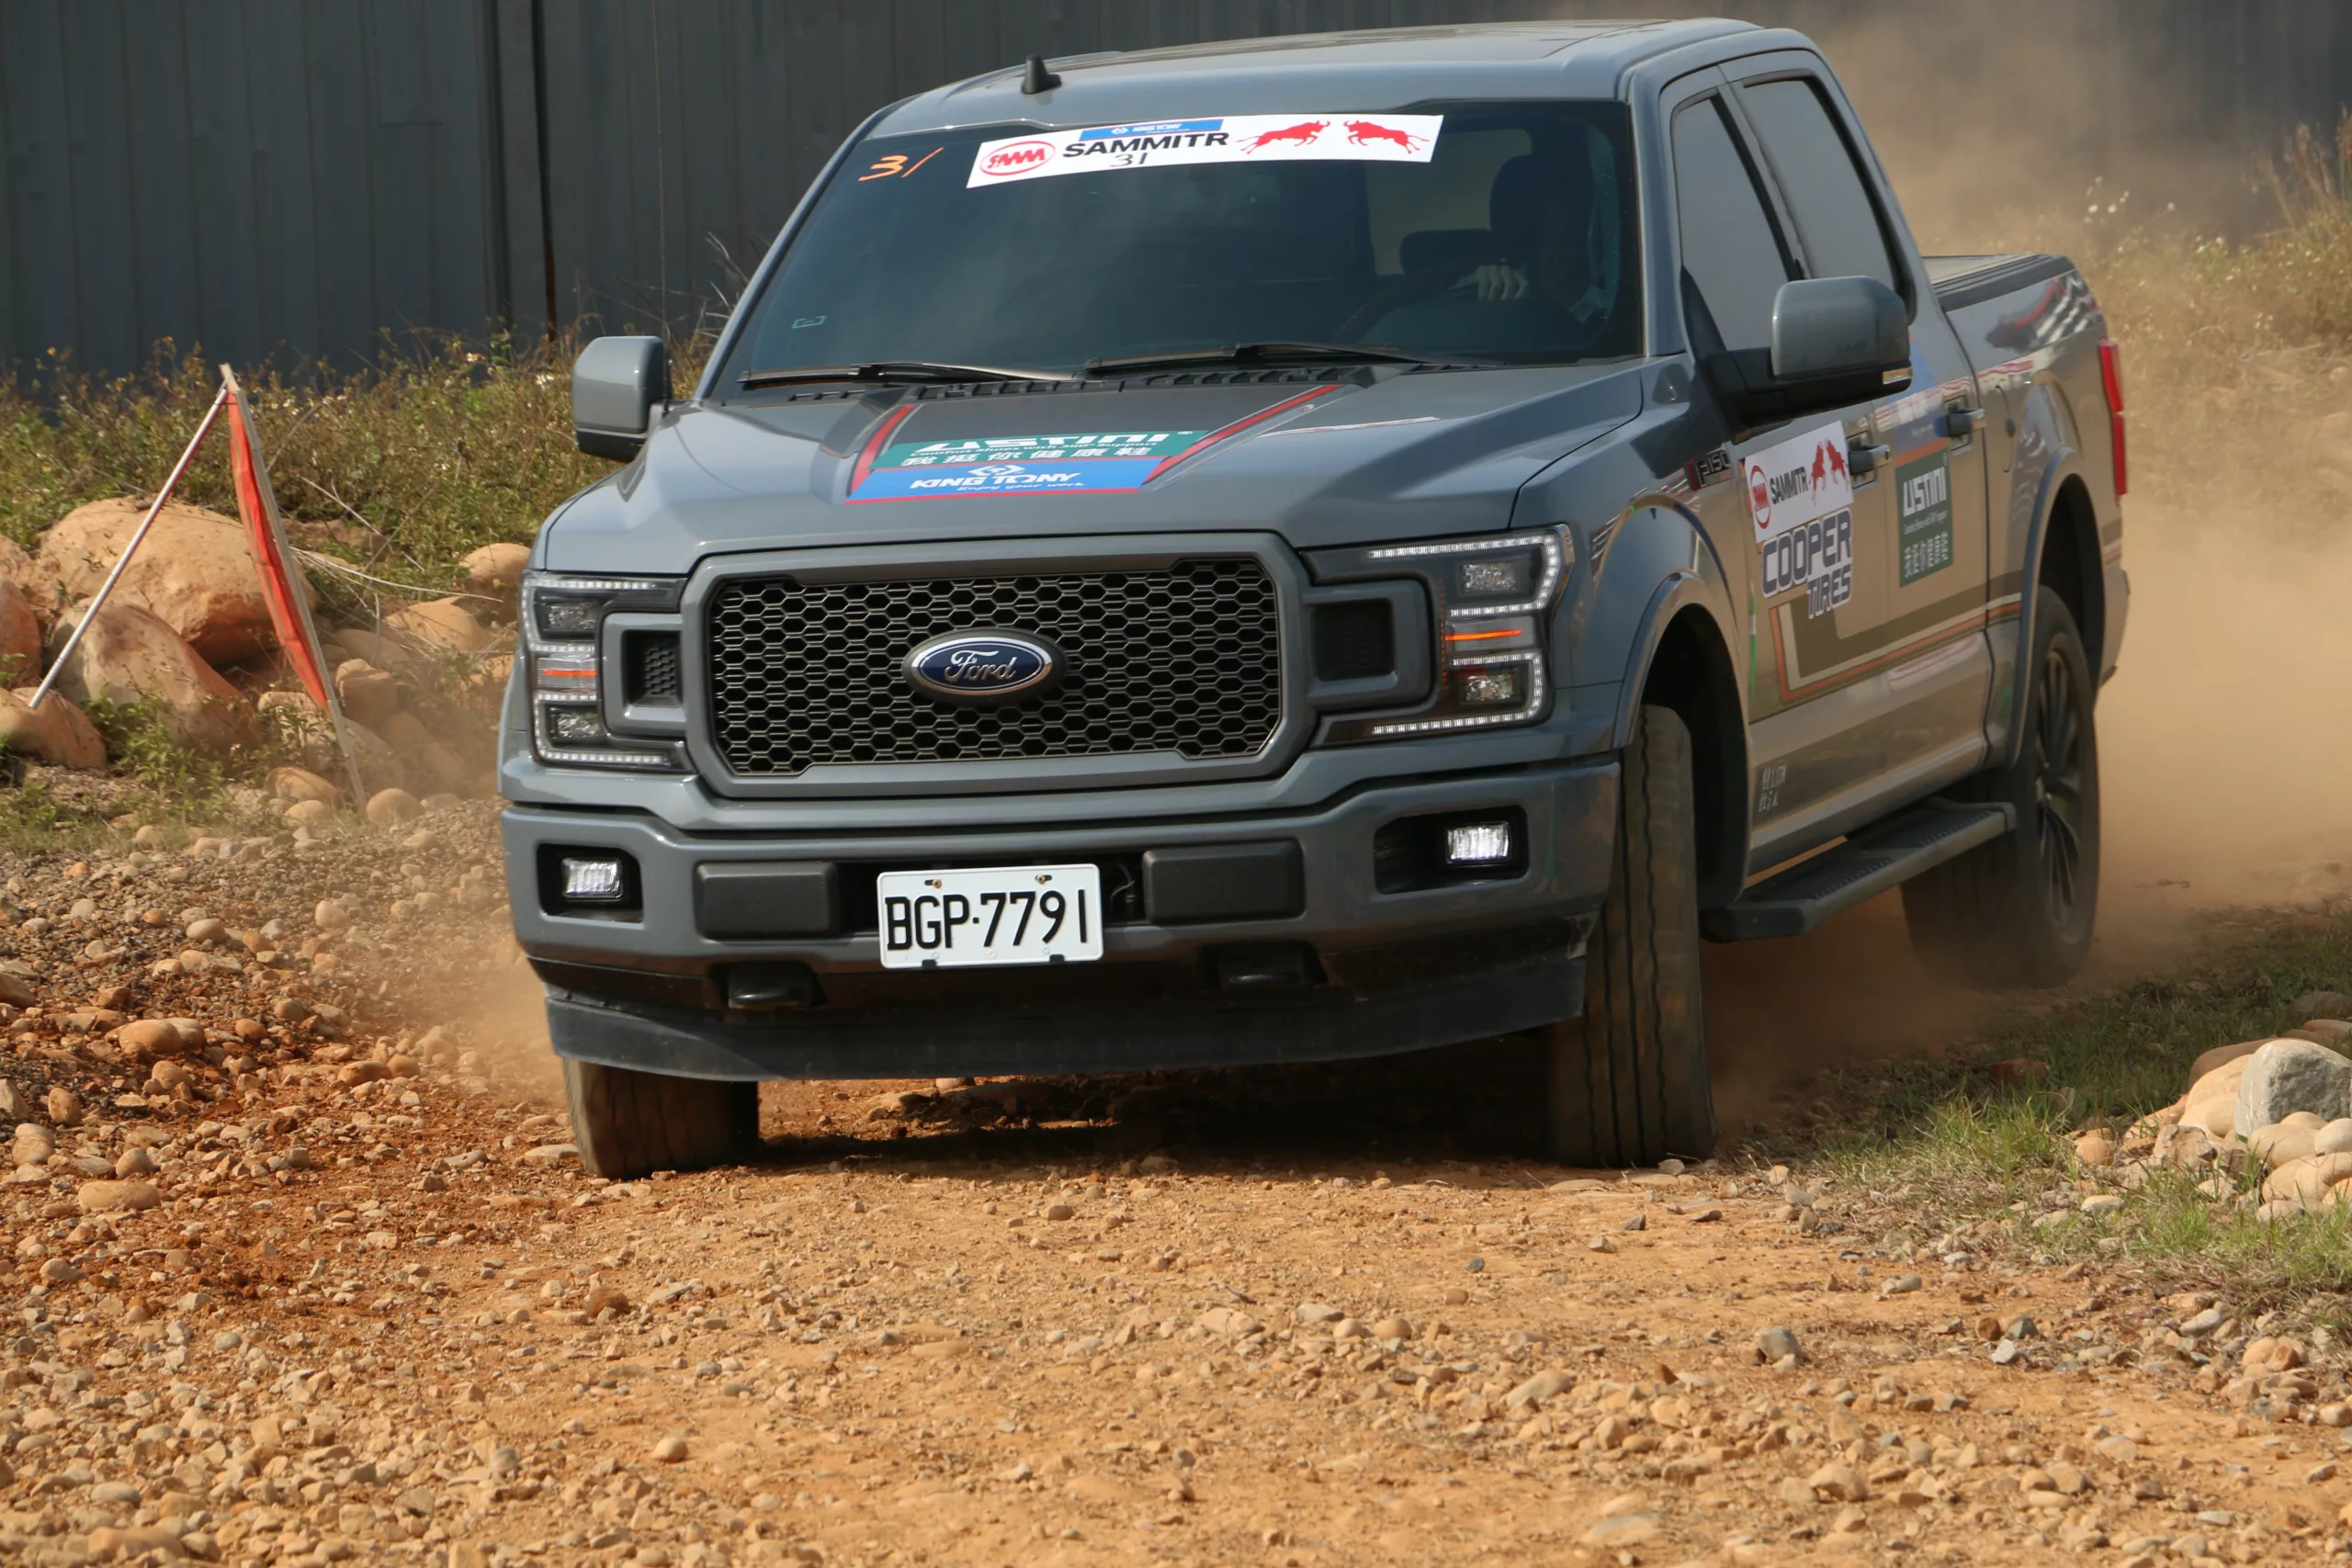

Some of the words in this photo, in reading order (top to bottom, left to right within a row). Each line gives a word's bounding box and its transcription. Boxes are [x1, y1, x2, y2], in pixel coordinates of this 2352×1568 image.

[1063, 132, 1229, 158] SAMMITR
[1110, 152, 1148, 167] 31
[910, 477, 988, 490] KING
[991, 472, 1081, 485] TONY
[1770, 467, 1809, 504] SAMMITR
[1761, 508, 1851, 597] COOPER
[1807, 563, 1852, 619] TIRES
[944, 649, 1018, 682] Ford
